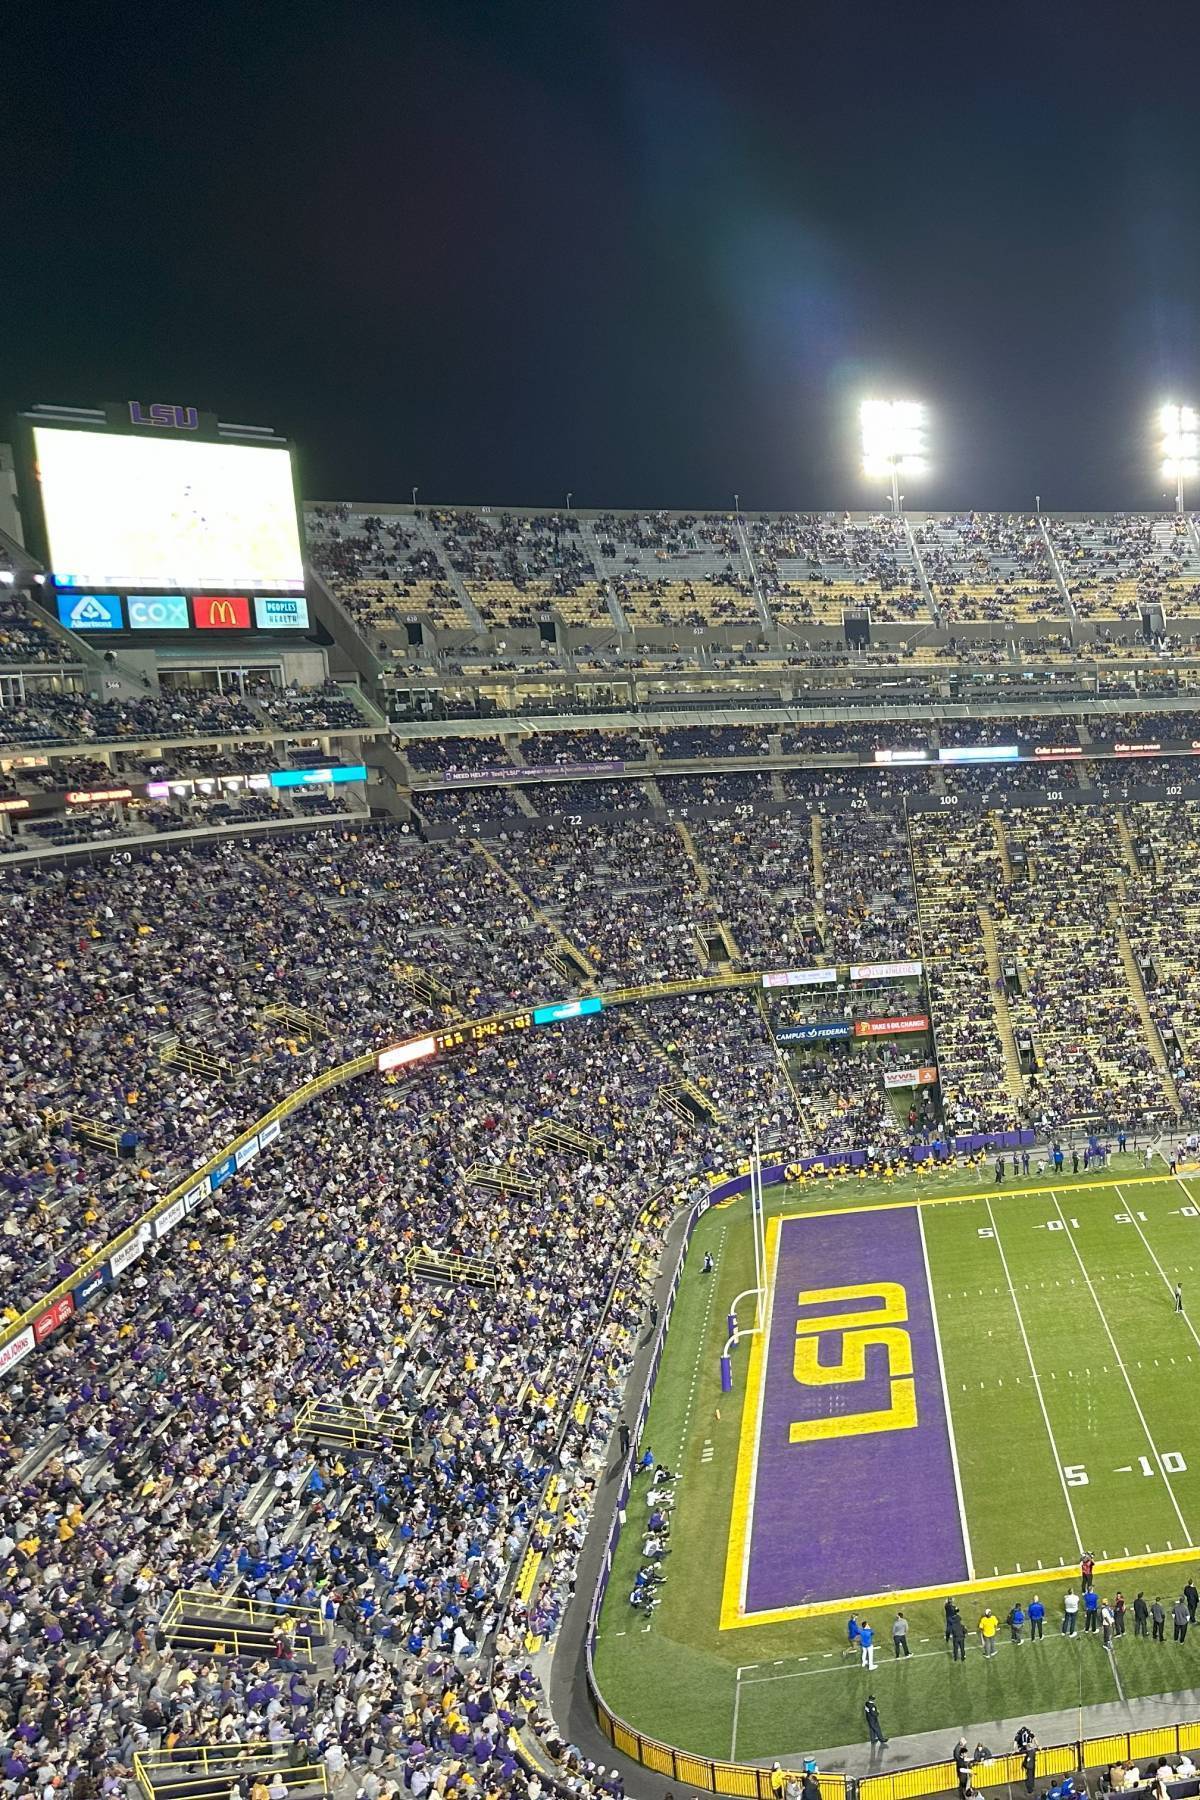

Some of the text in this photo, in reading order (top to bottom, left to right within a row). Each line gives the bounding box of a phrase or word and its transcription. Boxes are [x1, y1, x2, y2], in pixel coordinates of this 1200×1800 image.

[129, 401, 199, 430] LSU
[131, 603, 185, 621] COX
[269, 615, 298, 624] HEALTH
[470, 771, 489, 779] HELP?
[1046, 791, 1063, 800] 101
[1166, 787, 1182, 795] 102
[940, 796, 958, 805] 100
[735, 804, 754, 814] 423
[472, 1022, 498, 1038] 13:42
[899, 1020, 926, 1029] CHANGE
[776, 1028, 848, 1041] CAMPUS FEDERAL
[1114, 1211, 1149, 1224] 15
[1047, 1218, 1081, 1232] 10
[977, 1227, 995, 1239] 5
[789, 1282, 918, 1443] LSU
[1138, 1451, 1188, 1477] 10
[1063, 1464, 1090, 1488] 5
